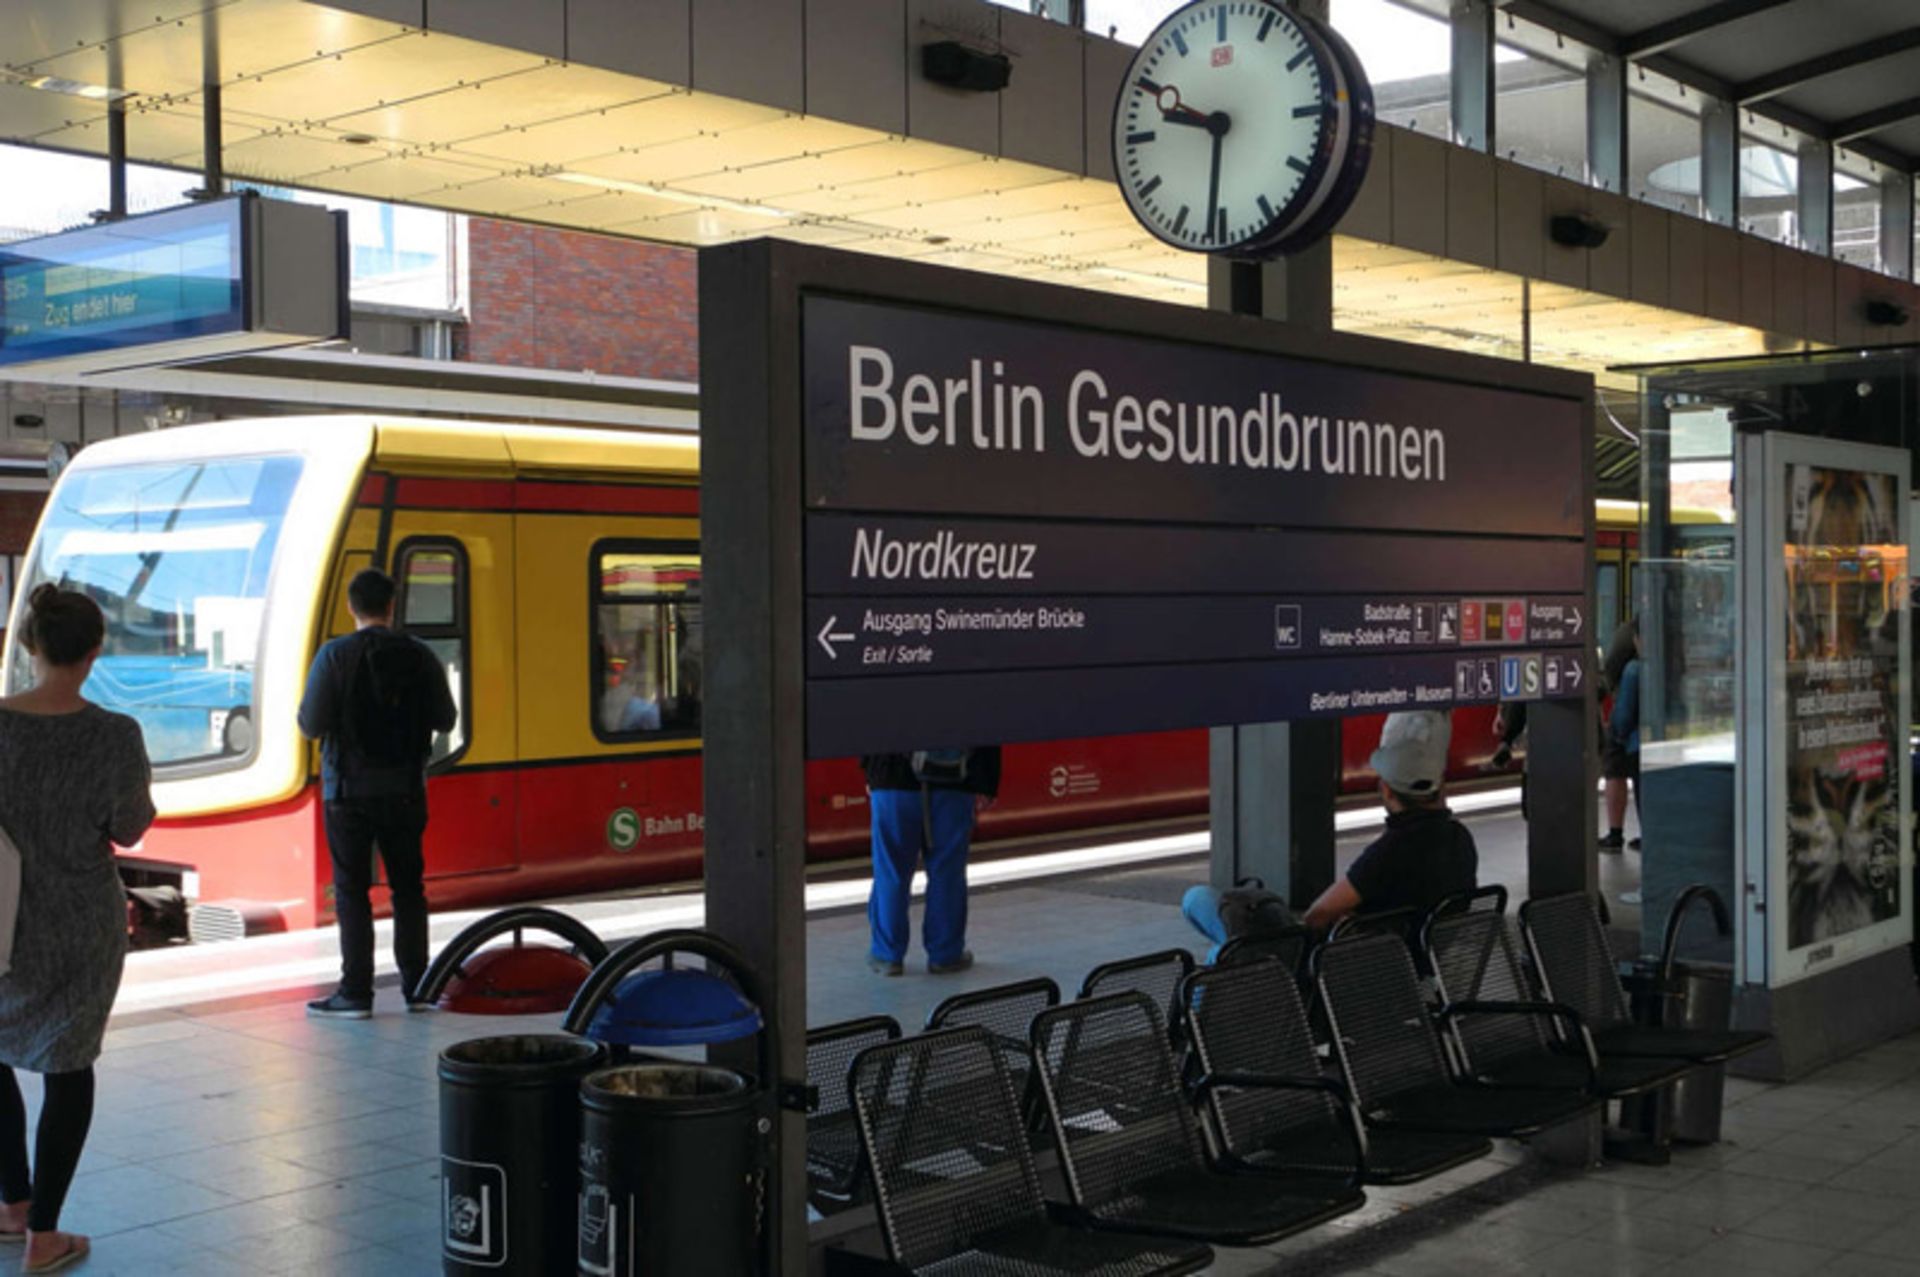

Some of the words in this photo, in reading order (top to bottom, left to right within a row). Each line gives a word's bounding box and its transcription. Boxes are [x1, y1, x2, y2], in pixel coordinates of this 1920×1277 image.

[849, 345, 1045, 451] Berlin
[1068, 370, 1447, 482] Gesundbrunnen
[851, 529, 1037, 580] Nordkreuz
[863, 609, 931, 635] Ausgang
[935, 608, 1034, 630] Swinemünder
[1038, 608, 1085, 628] Brücke
[1278, 626, 1295, 643] WC
[863, 647, 886, 664] Exit
[897, 645, 933, 663] Sortie
[1504, 660, 1518, 693] U
[1525, 660, 1539, 692] S
[644, 815, 684, 837] Bahn
